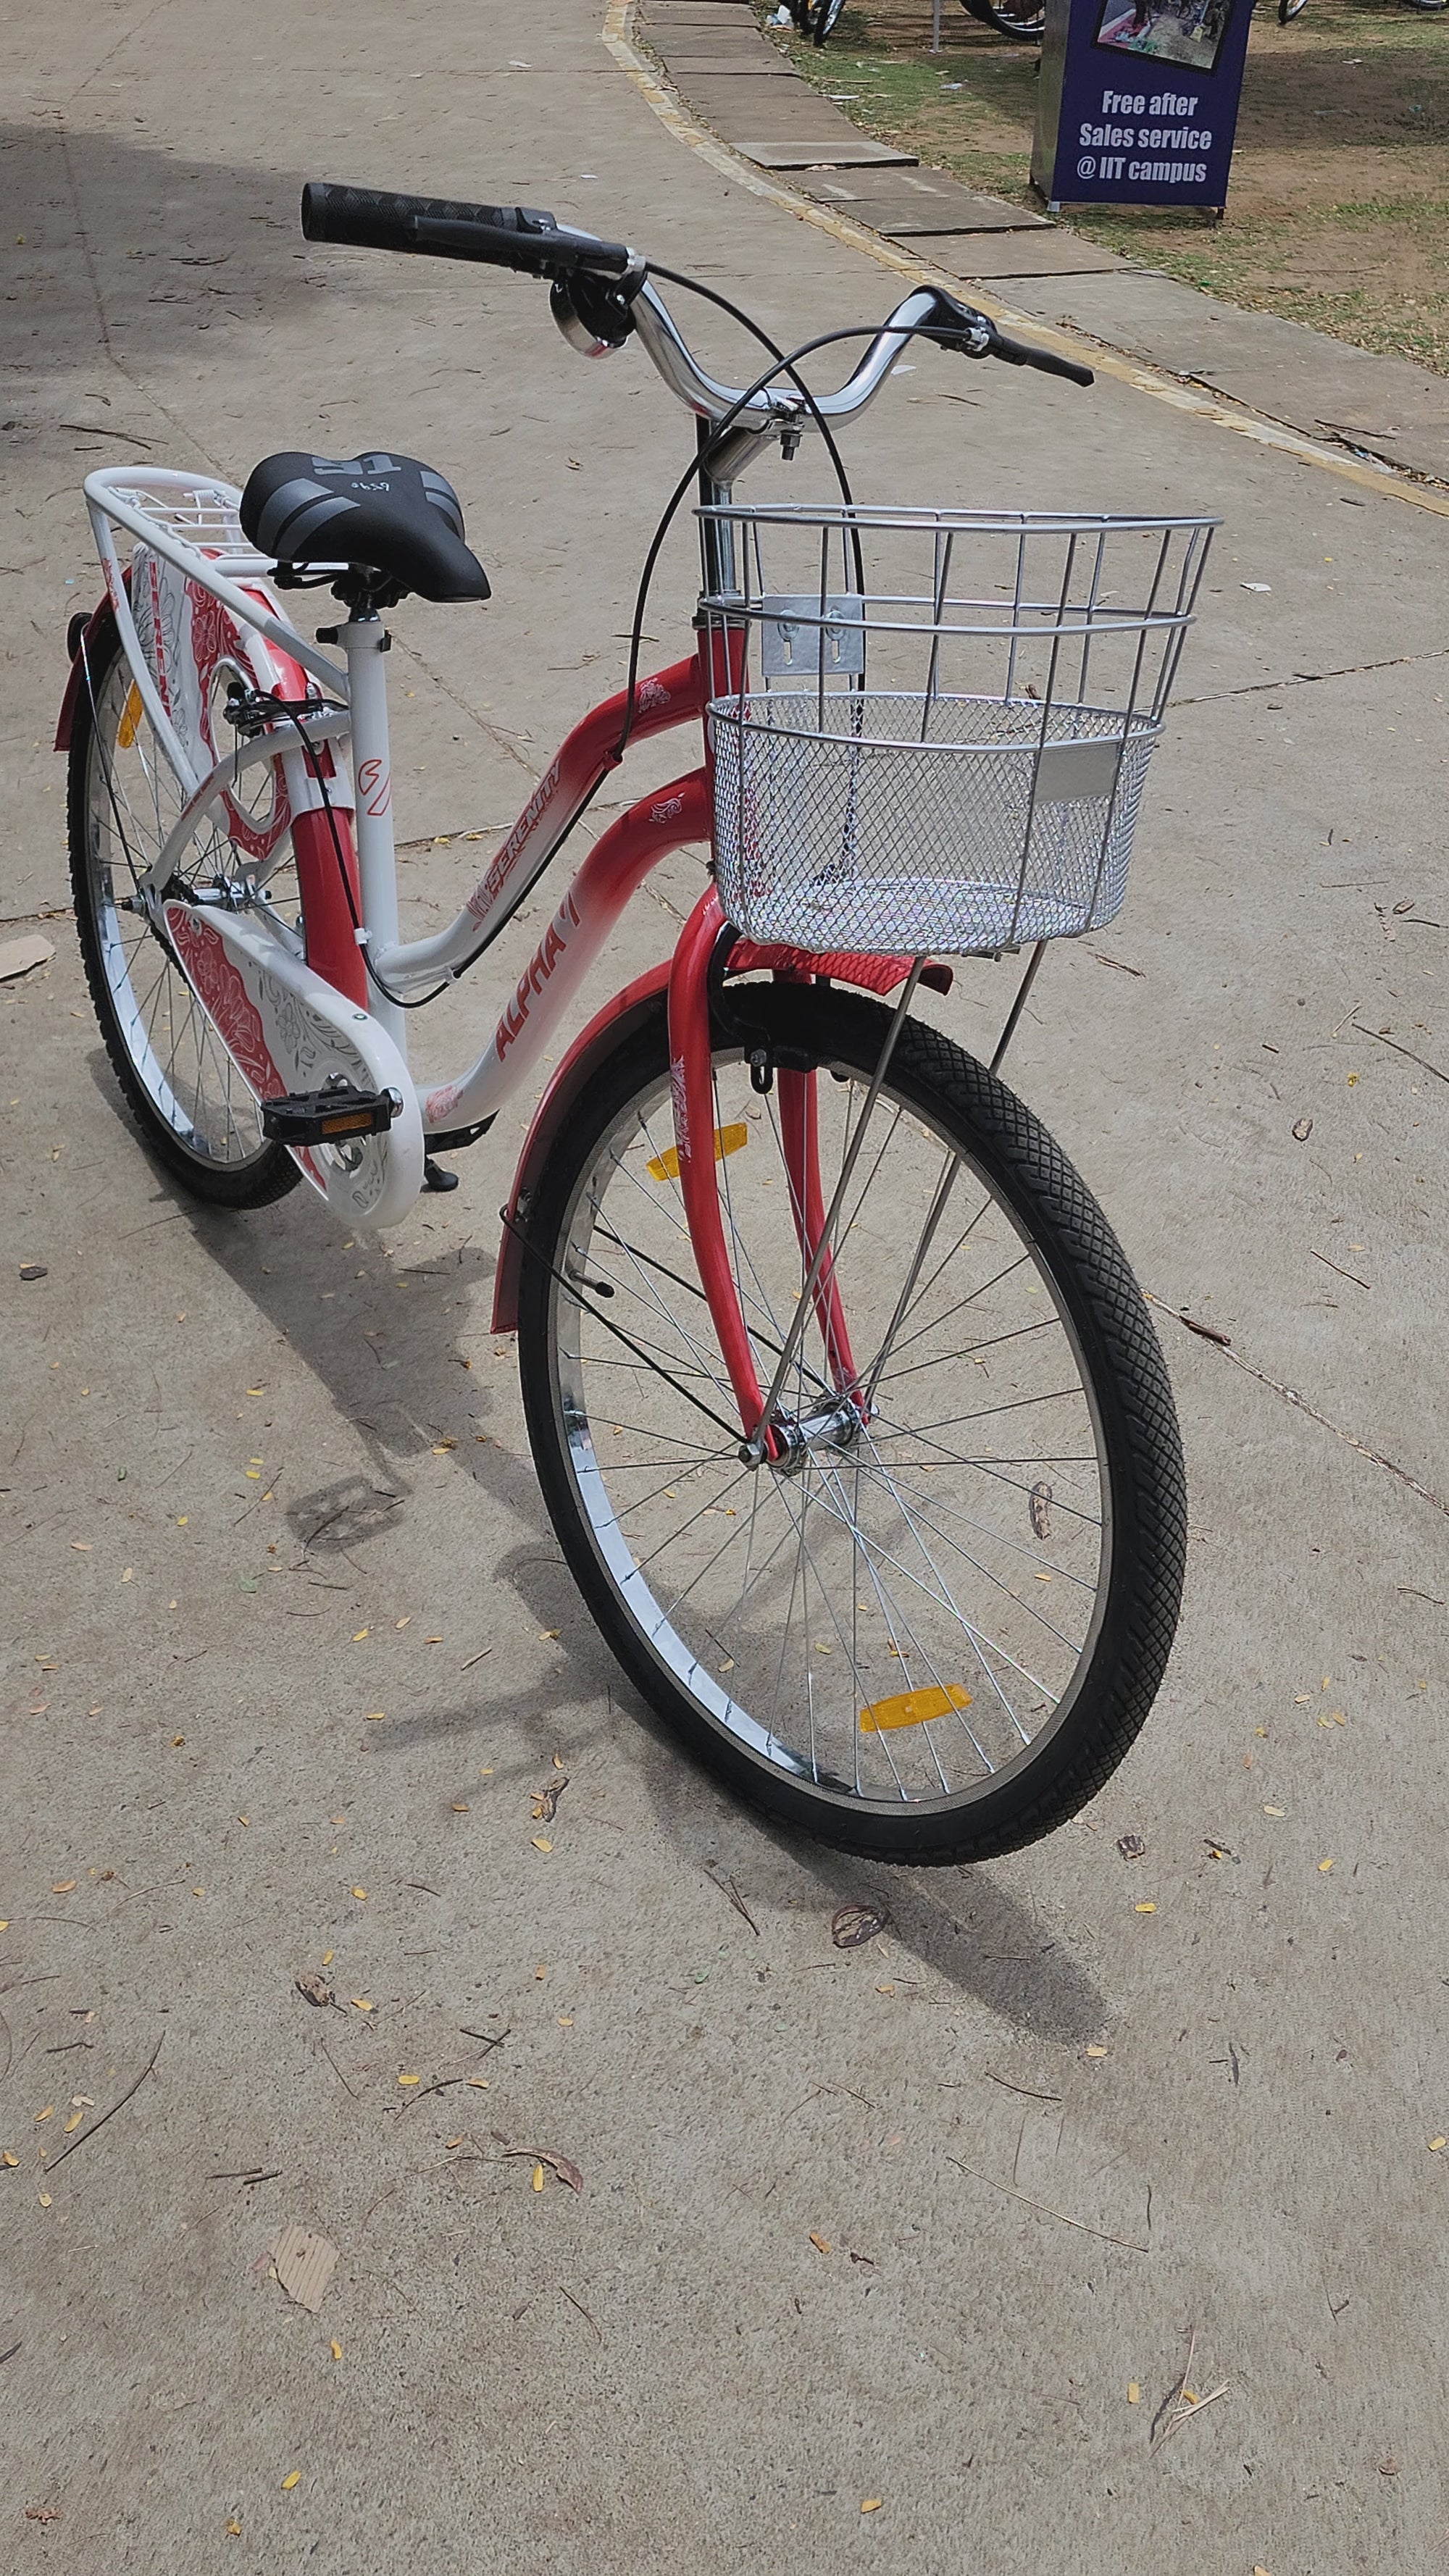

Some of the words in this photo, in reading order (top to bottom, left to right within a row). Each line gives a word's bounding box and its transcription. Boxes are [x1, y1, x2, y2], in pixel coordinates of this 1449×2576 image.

[1101, 91, 1145, 114] Free
[1148, 92, 1198, 116] after
[1079, 122, 1135, 147] Sales
[1137, 126, 1212, 150] service
[1077, 156, 1096, 179] @
[1099, 156, 1127, 180] IIT
[1128, 161, 1207, 183] campus
[486, 755, 561, 895] SERENITY
[495, 921, 567, 1063] ALPHA
